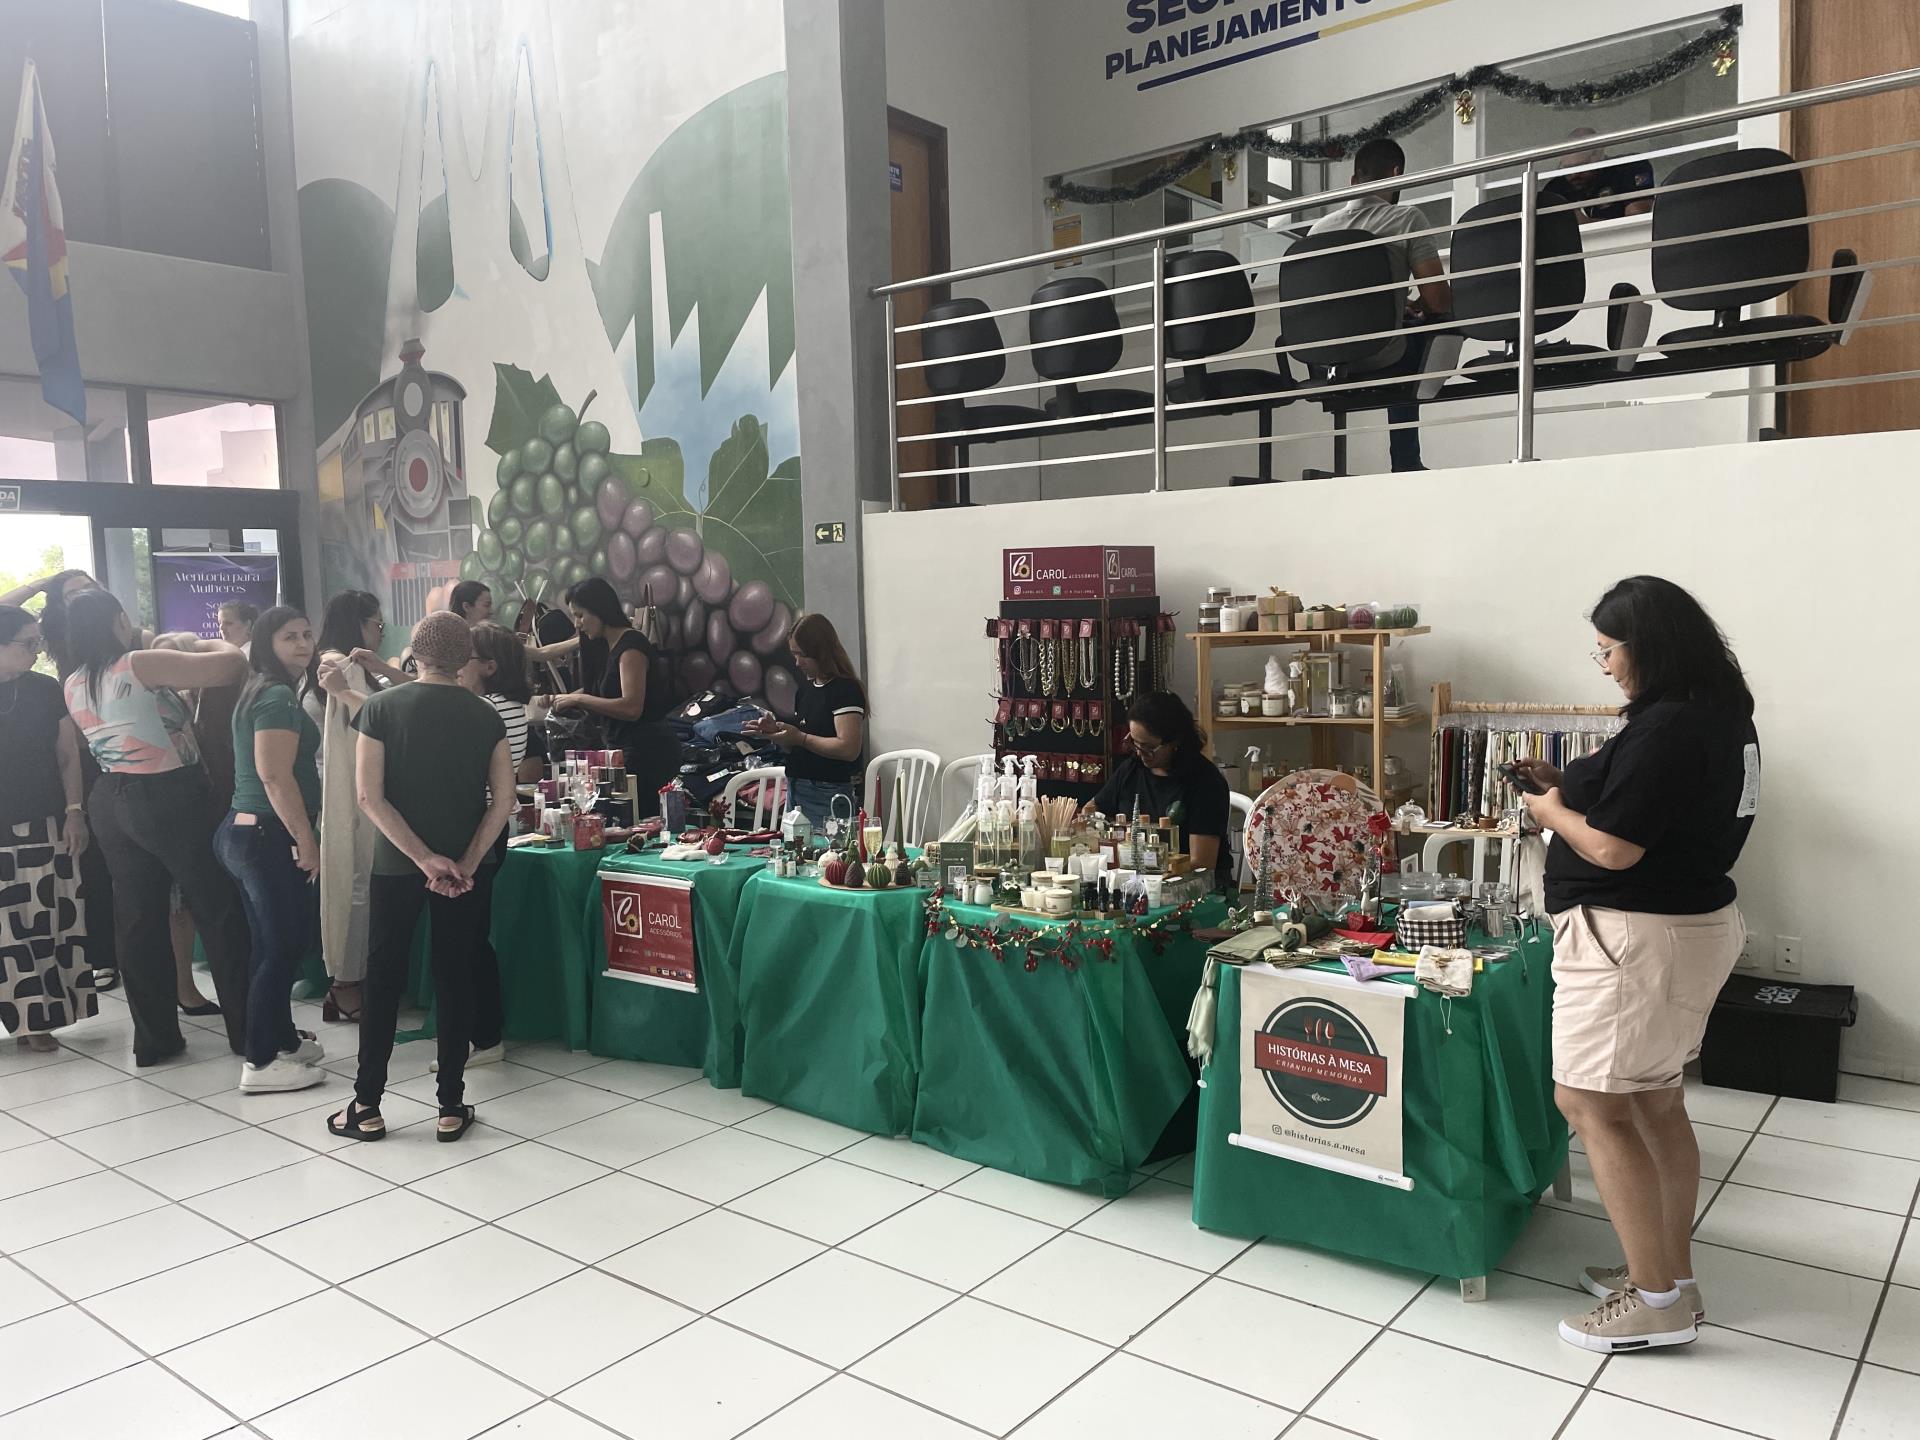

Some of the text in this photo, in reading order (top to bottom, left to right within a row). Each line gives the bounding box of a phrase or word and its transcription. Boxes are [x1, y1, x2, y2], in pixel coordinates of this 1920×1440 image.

[1105, 0, 1372, 80] PLANEJAMEN
[175, 572, 260, 583] Mentoria para
[1036, 568, 1067, 580] CAROL
[1121, 567, 1138, 578] CAROL
[190, 583, 247, 593] Mulheres
[648, 912, 682, 929] CAROL
[1268, 1043, 1372, 1076] HISTÓRIAS À MESA
[1276, 1059, 1364, 1084] CRIANDO MEMÓRIAS
[1284, 1129, 1366, 1156] @historias.a.mesa
